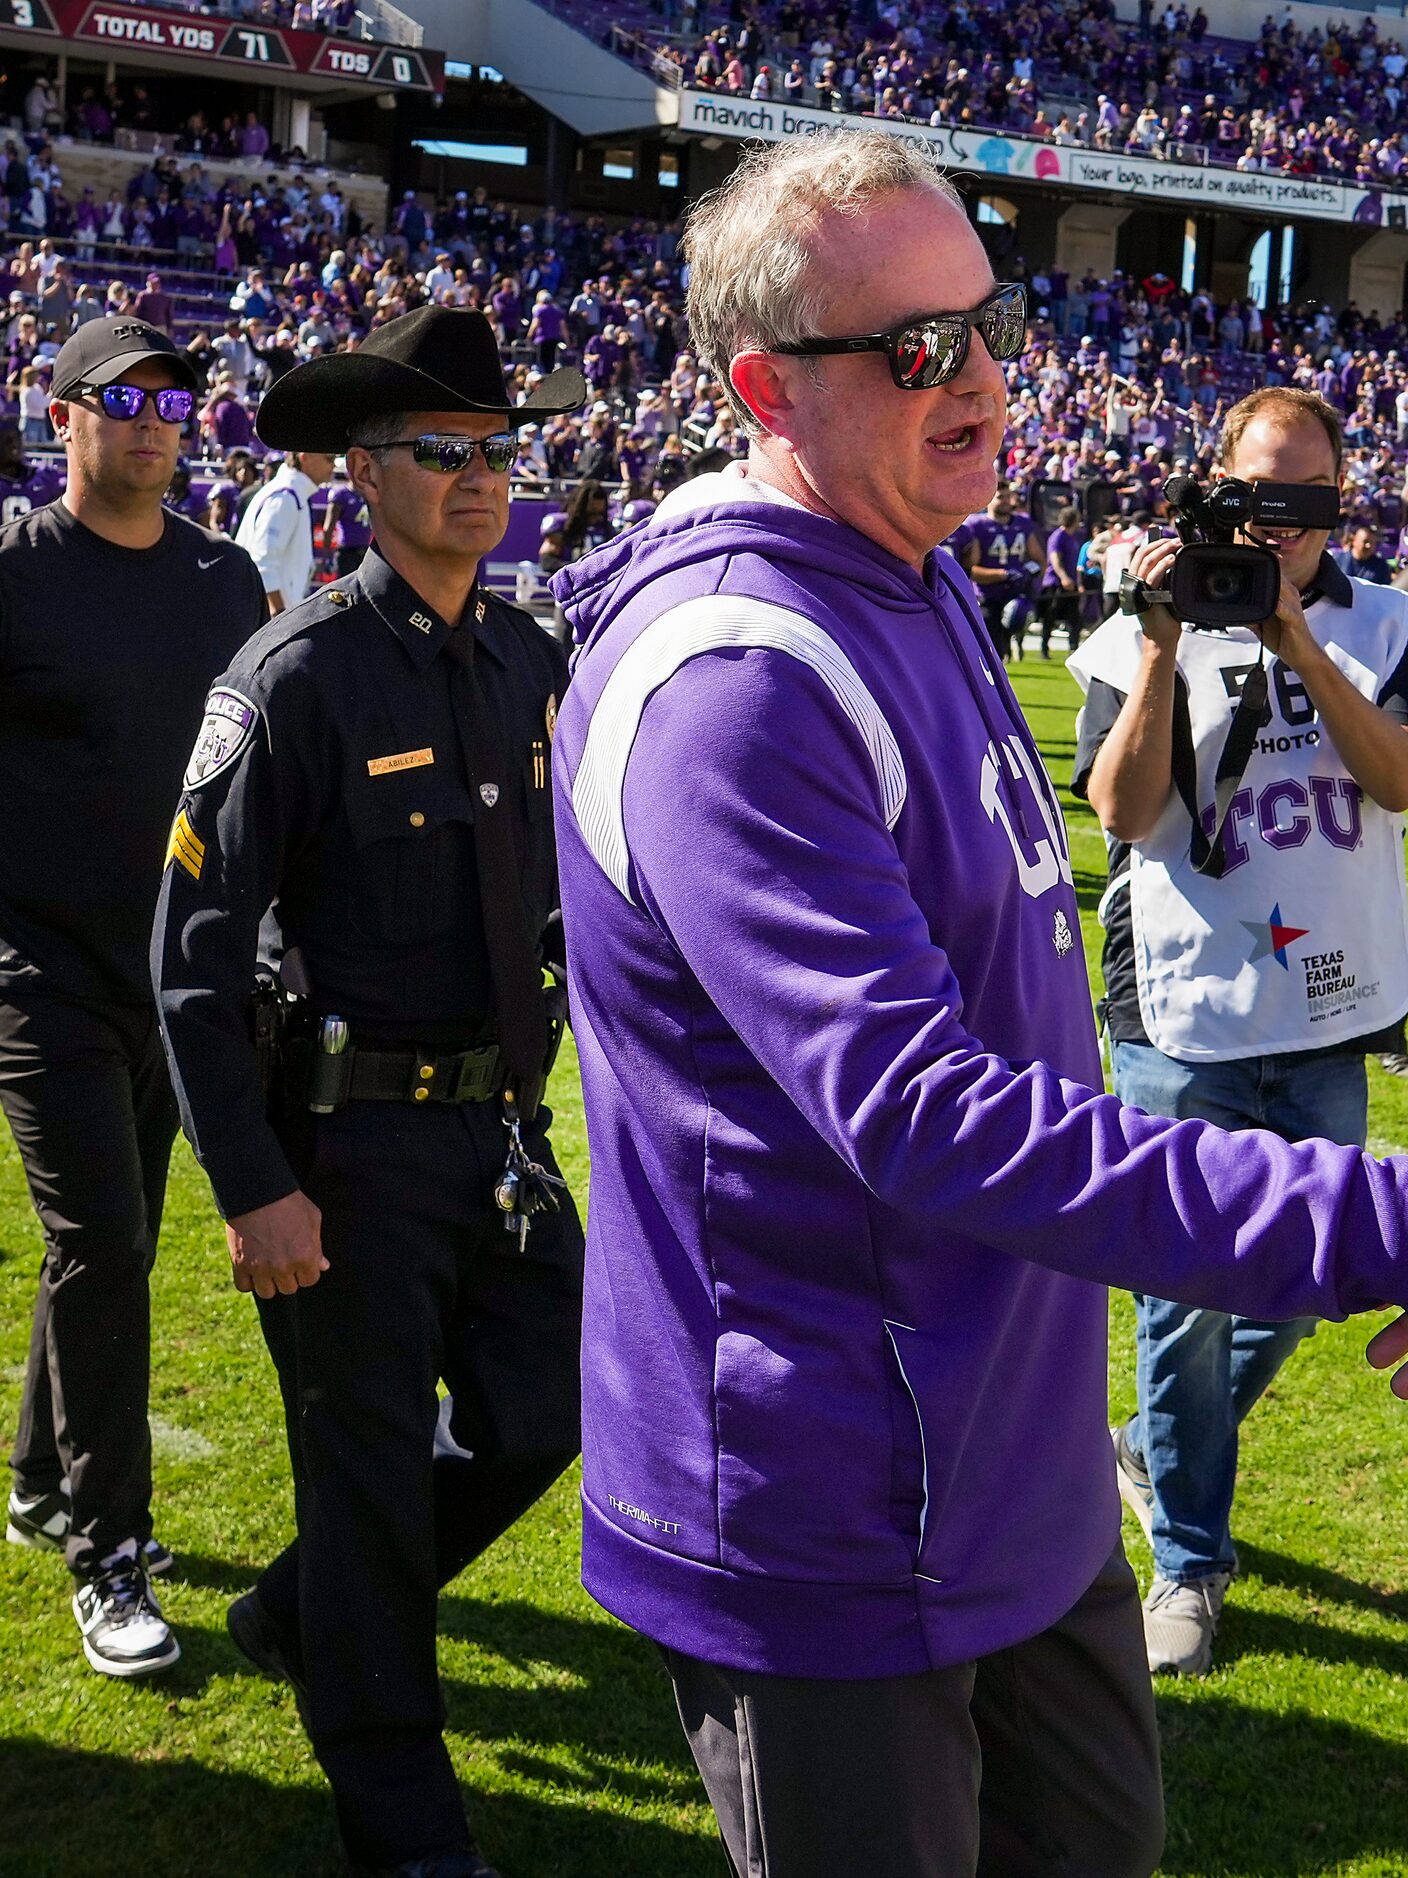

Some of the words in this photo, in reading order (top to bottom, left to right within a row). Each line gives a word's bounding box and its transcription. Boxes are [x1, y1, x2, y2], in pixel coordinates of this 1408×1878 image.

[94, 13, 165, 43] TOTAL
[169, 25, 215, 50] YDS
[237, 31, 269, 61] 71
[328, 49, 370, 74] TDS
[394, 56, 411, 83] 0
[693, 99, 773, 131] mavich
[1080, 164, 1113, 182] Your
[1152, 171, 1205, 190] printed
[1207, 180, 1223, 192] on
[112, 323, 152, 340] TC
[1222, 498, 1240, 506] JVC
[987, 532, 1026, 565] 44
[205, 695, 246, 724] OLICE
[198, 735, 229, 765] CU
[1250, 729, 1320, 756] PHOTO
[1199, 776, 1364, 880] TCU
[1300, 950, 1345, 970] TEXAS
[1306, 964, 1342, 985] FARM
[1307, 974, 1356, 999] BUREAU
[1309, 1013, 1326, 1022] AUTO
[1345, 1004, 1357, 1012] LIFE
[607, 1493, 682, 1535] THERMA-FIT
